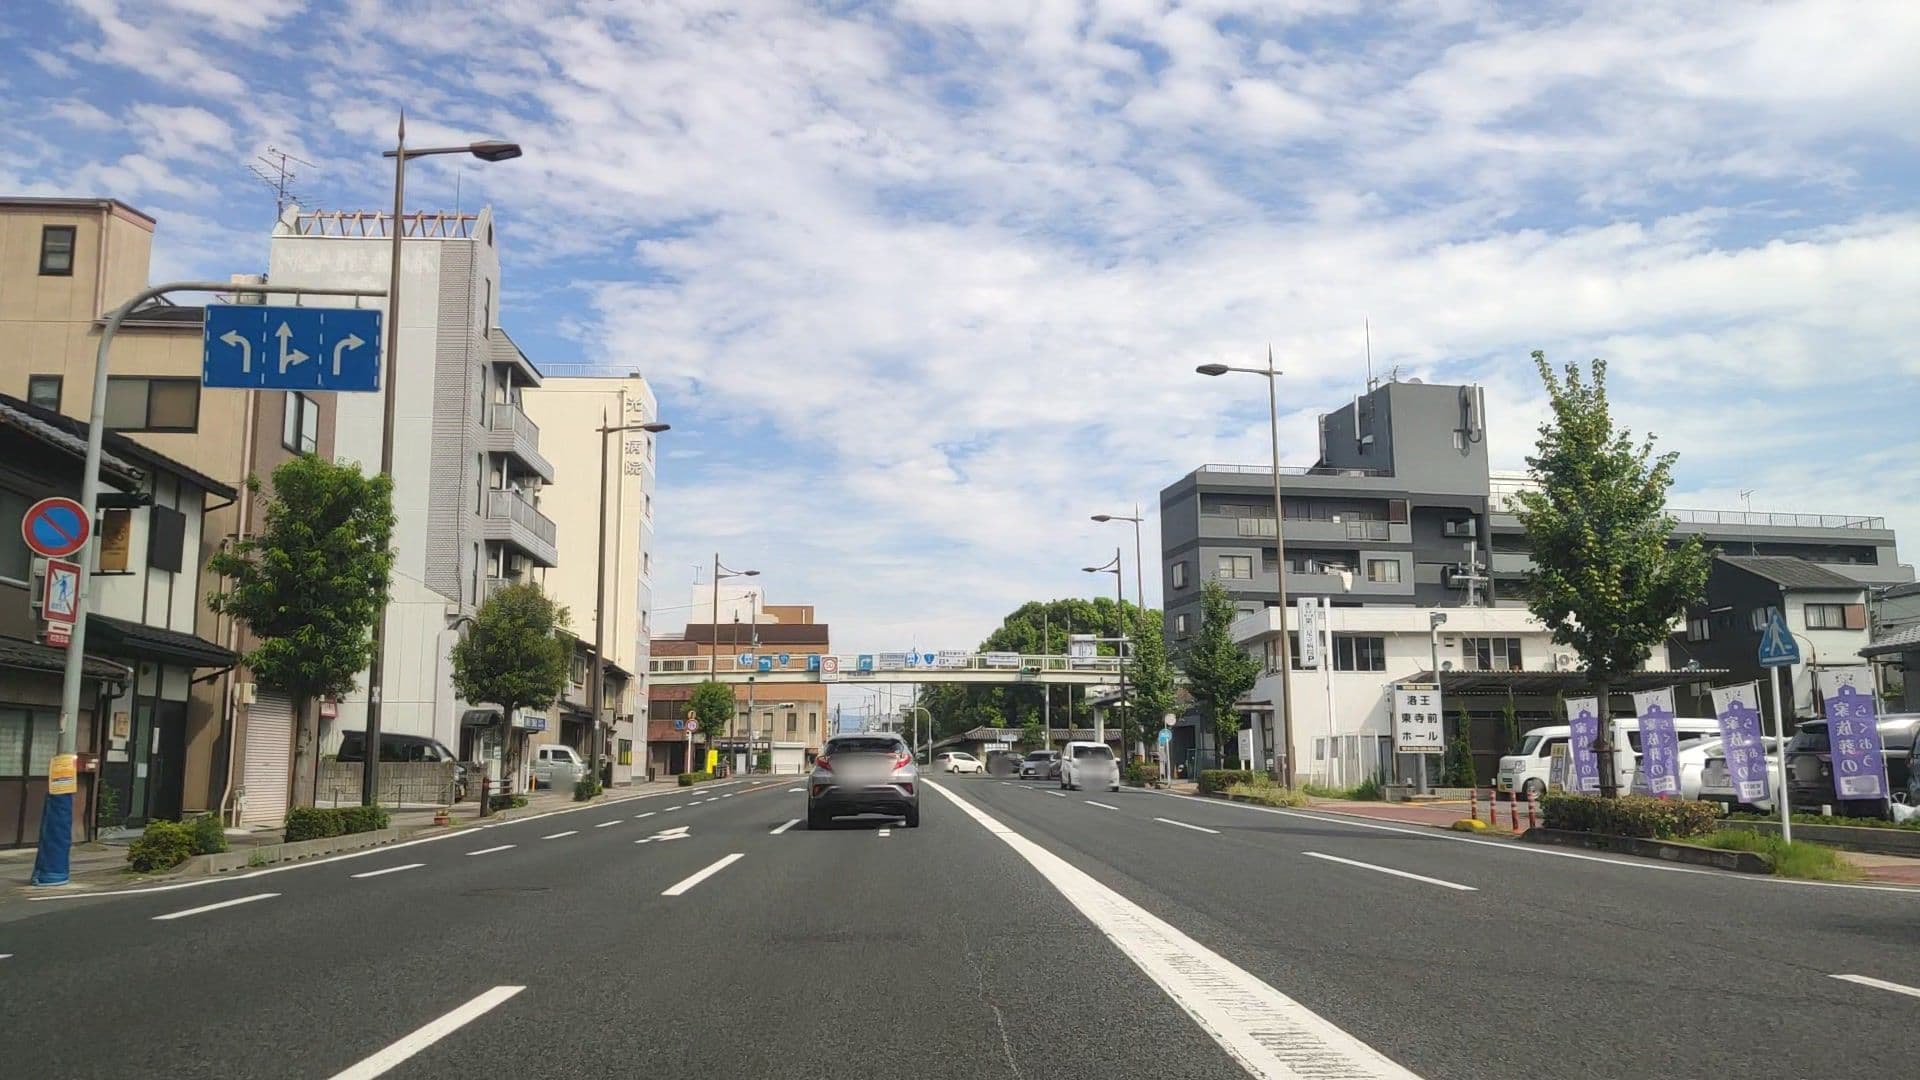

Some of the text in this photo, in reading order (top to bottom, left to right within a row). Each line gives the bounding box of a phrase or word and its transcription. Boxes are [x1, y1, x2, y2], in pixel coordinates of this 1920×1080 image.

[1407, 695, 1431, 706] 洛王
[1401, 713, 1438, 724] 東寺前
[1402, 732, 1438, 742] ホール
